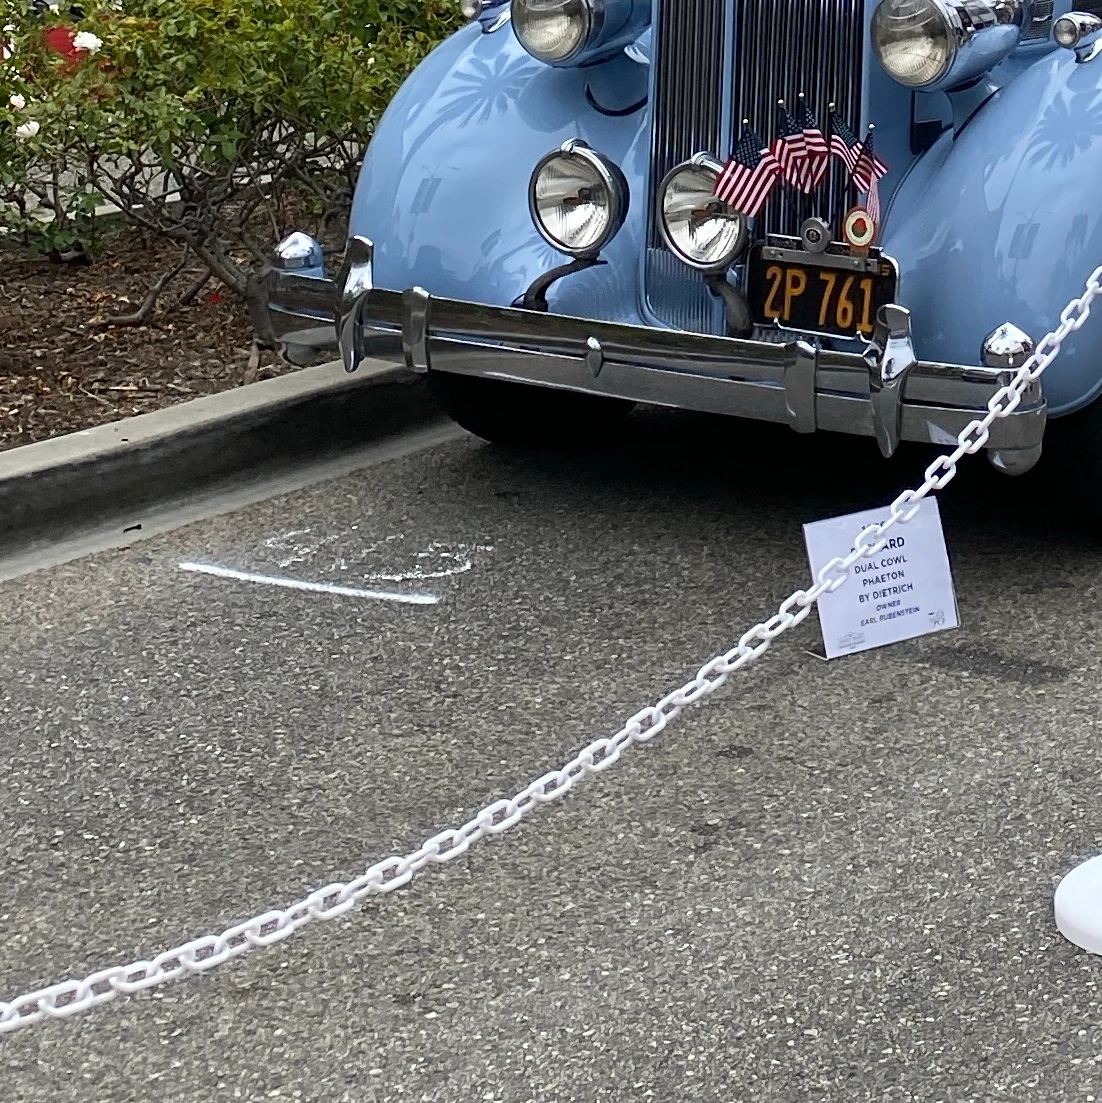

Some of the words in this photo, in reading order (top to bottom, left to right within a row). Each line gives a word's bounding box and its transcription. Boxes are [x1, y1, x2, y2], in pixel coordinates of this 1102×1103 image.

[764, 264, 808, 321] 2P
[818, 271, 874, 333] 761
[854, 562, 879, 574] DUAL
[881, 555, 908, 568] COWL
[862, 570, 905, 587] PHAETON
[858, 593, 870, 603] BY
[872, 582, 914, 600] DIETRICH
[876, 600, 901, 611] OWNER
[860, 617, 878, 627] EARL
